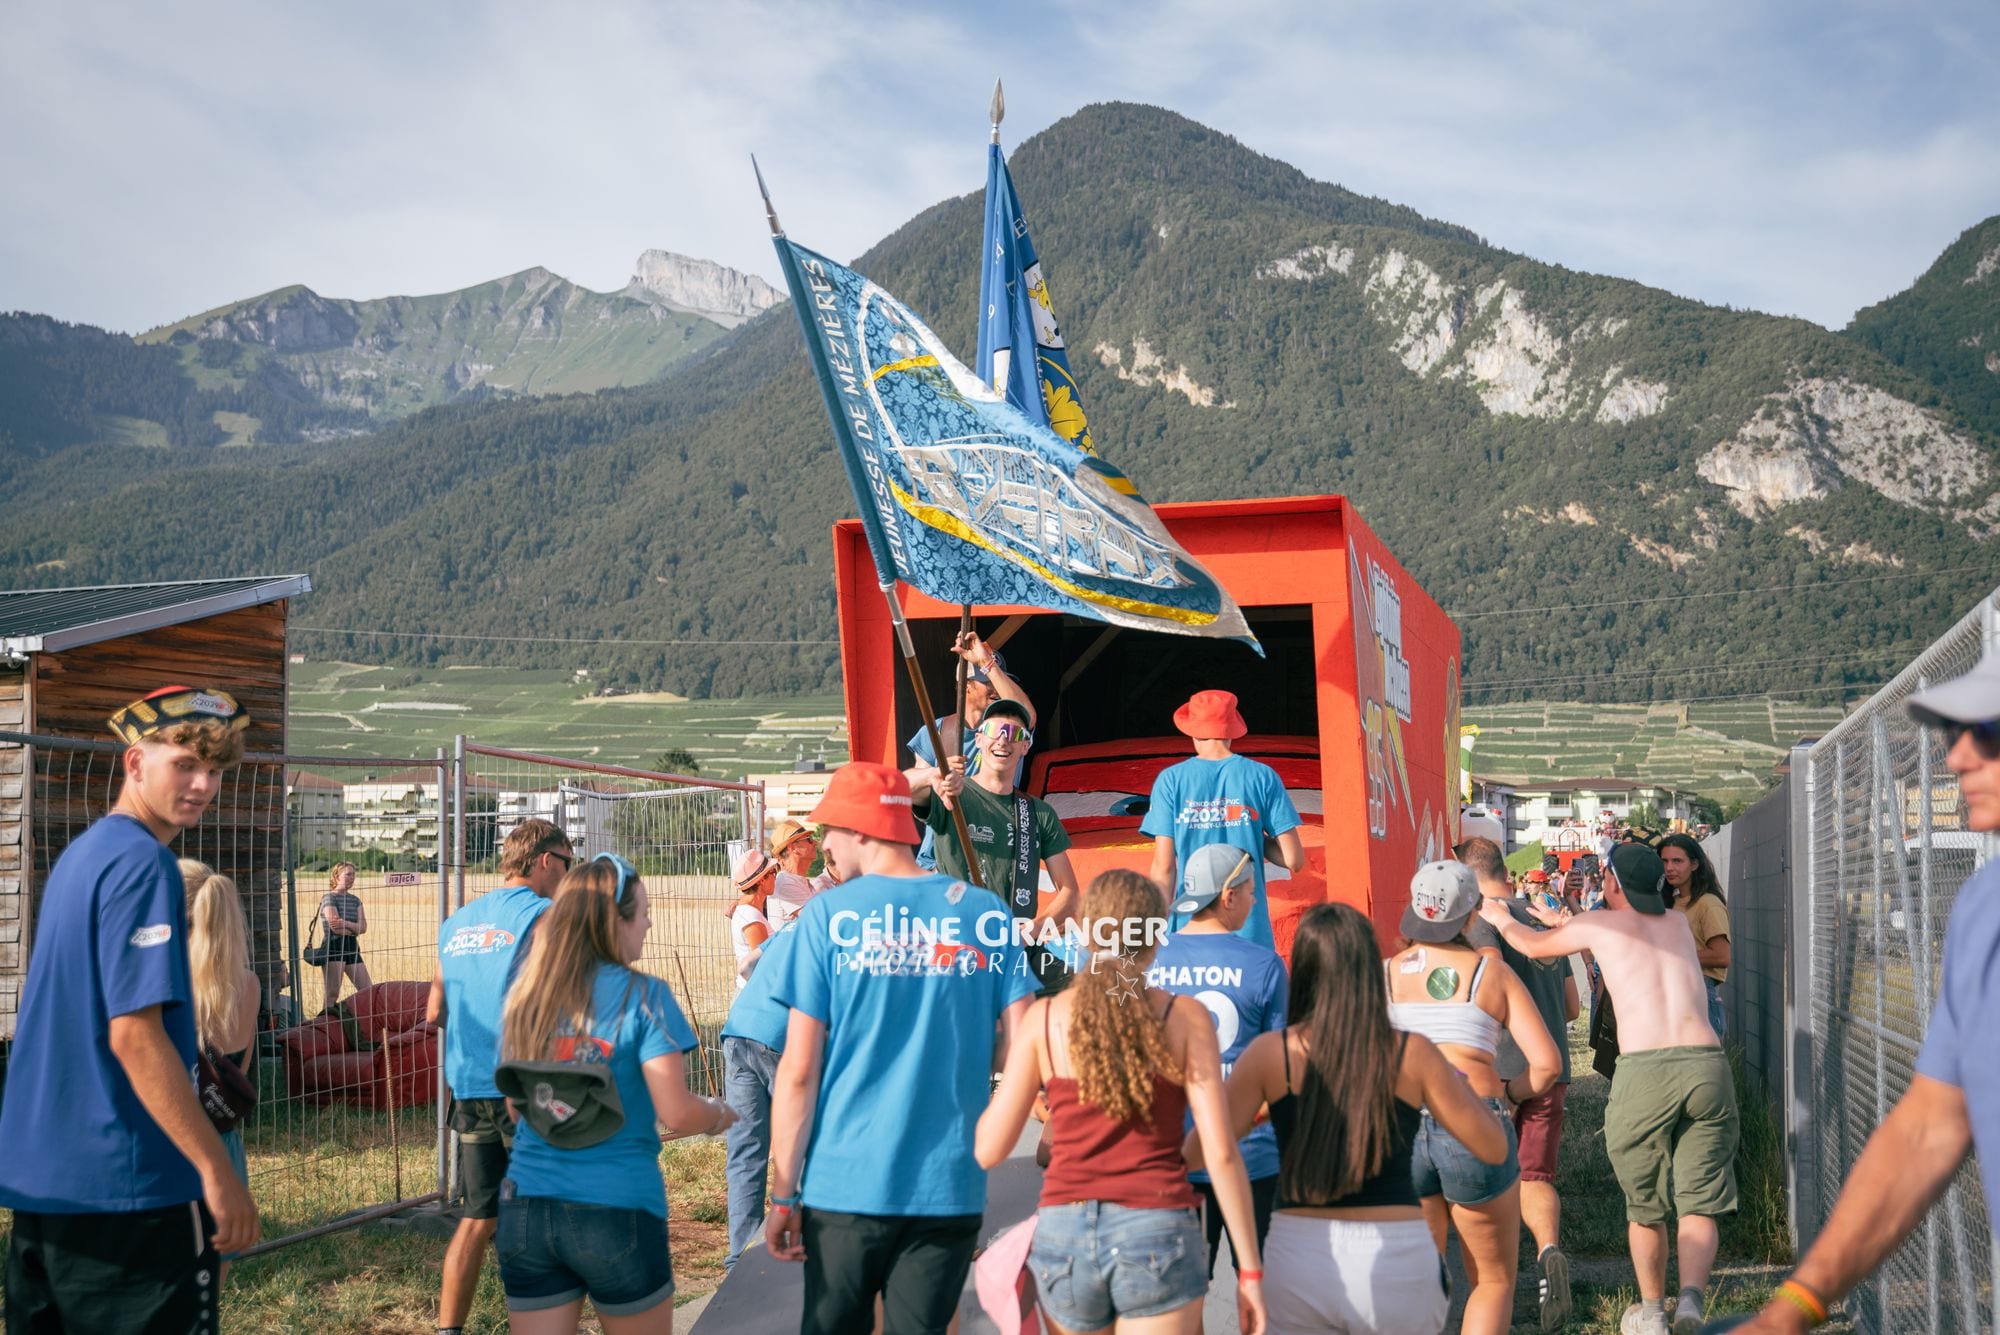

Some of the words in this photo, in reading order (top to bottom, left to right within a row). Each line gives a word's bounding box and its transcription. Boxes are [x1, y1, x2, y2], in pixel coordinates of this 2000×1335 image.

[801, 258, 862, 396] MÉZIÈRES
[849, 403, 874, 441] DE
[863, 446, 910, 575] JEUNESSE
[1189, 807, 1227, 822] 2029
[1019, 834, 1029, 874] JEUNESSE
[1148, 965, 1242, 988] CHATON
